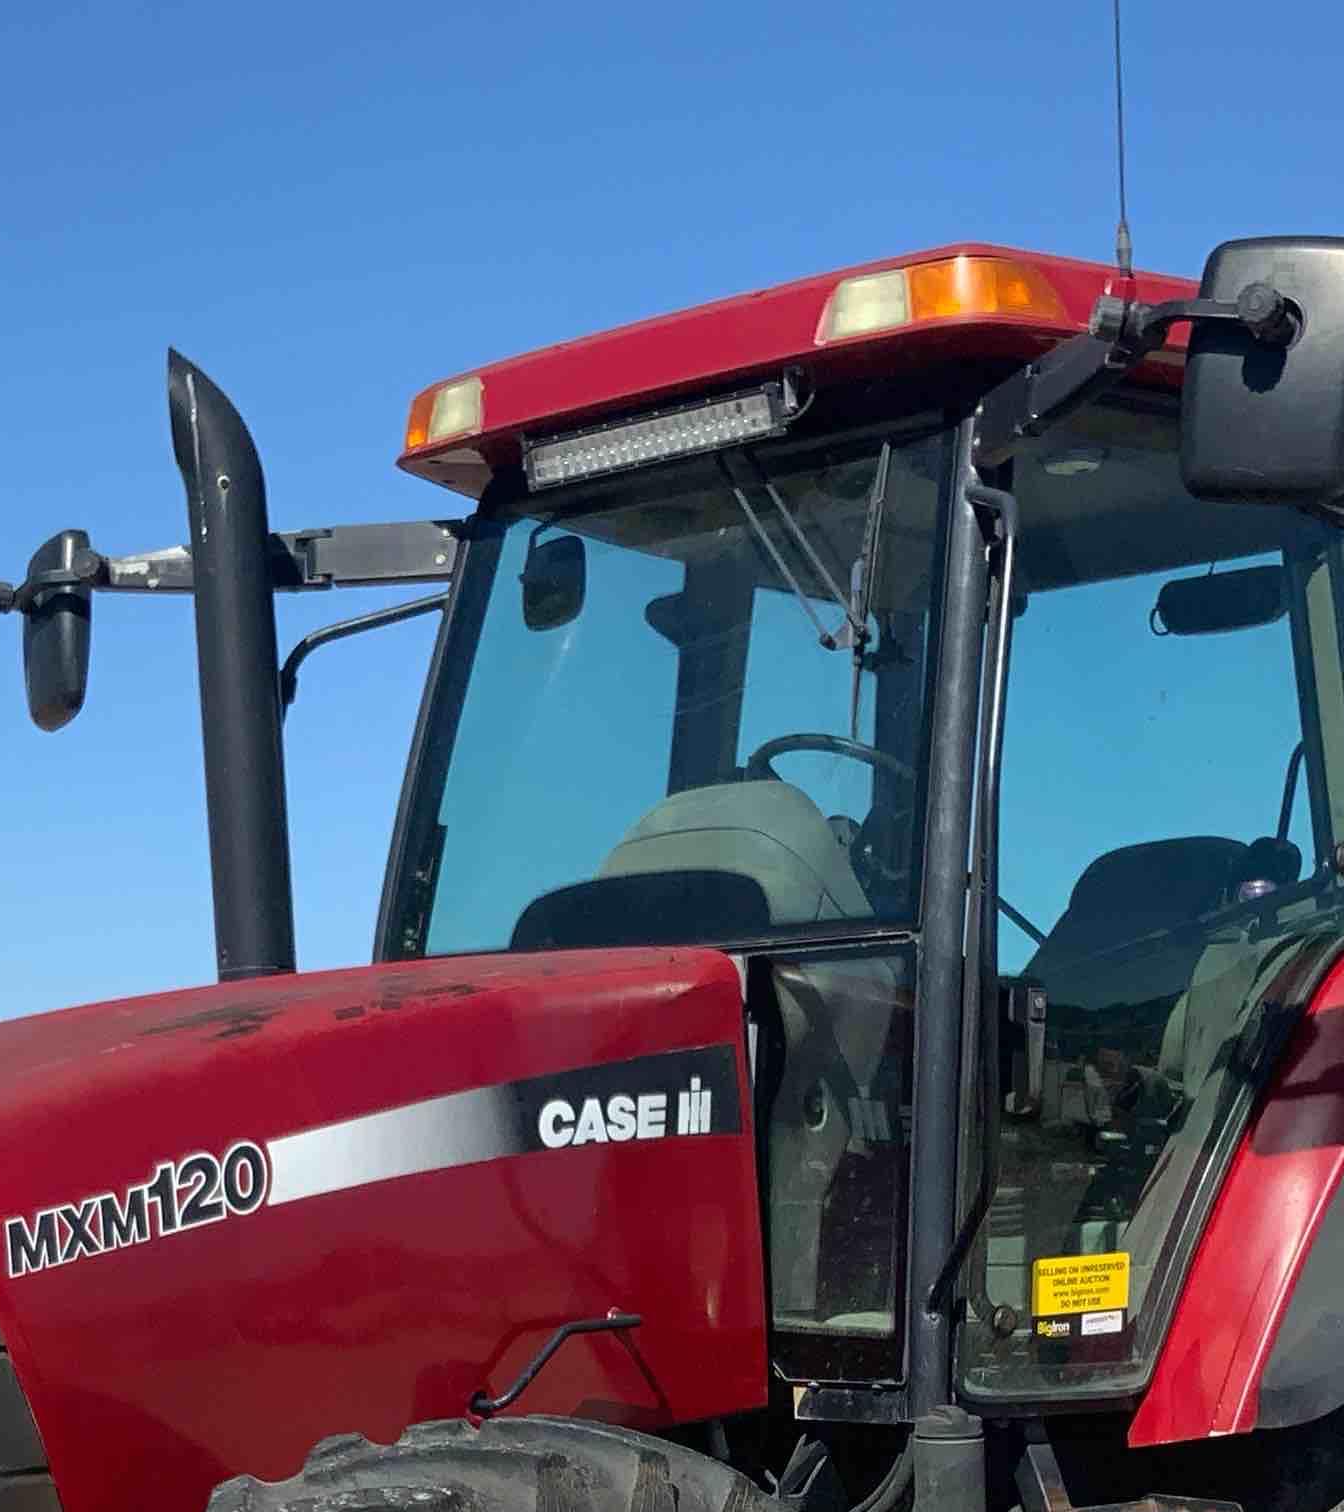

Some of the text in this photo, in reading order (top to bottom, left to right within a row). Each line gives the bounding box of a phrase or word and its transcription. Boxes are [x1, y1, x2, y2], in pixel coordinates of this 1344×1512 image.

[538, 1095, 666, 1149] CASE
[6, 1142, 273, 1277] MXM120
[1039, 1266, 1067, 1277] SELLING
[1080, 1261, 1125, 1273] UNRESERVED
[1052, 1275, 1110, 1287] ONLINE AUCTION
